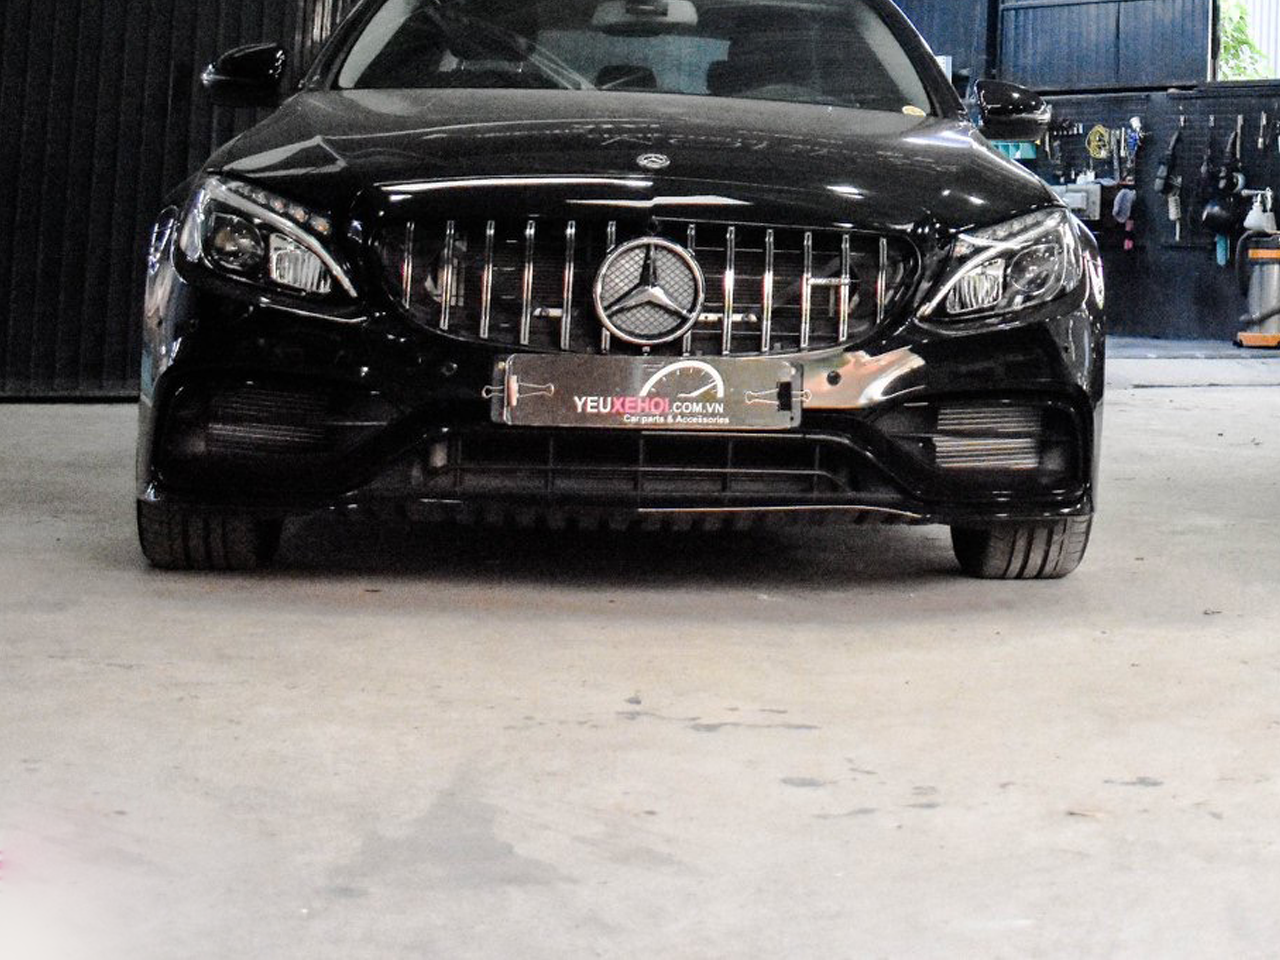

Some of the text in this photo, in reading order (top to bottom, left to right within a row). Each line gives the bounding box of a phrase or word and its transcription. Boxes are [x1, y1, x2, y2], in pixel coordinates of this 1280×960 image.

[574, 395, 724, 414] YEUXEHOI.COM.VN
[623, 413, 730, 425] Car parts & Accessories
